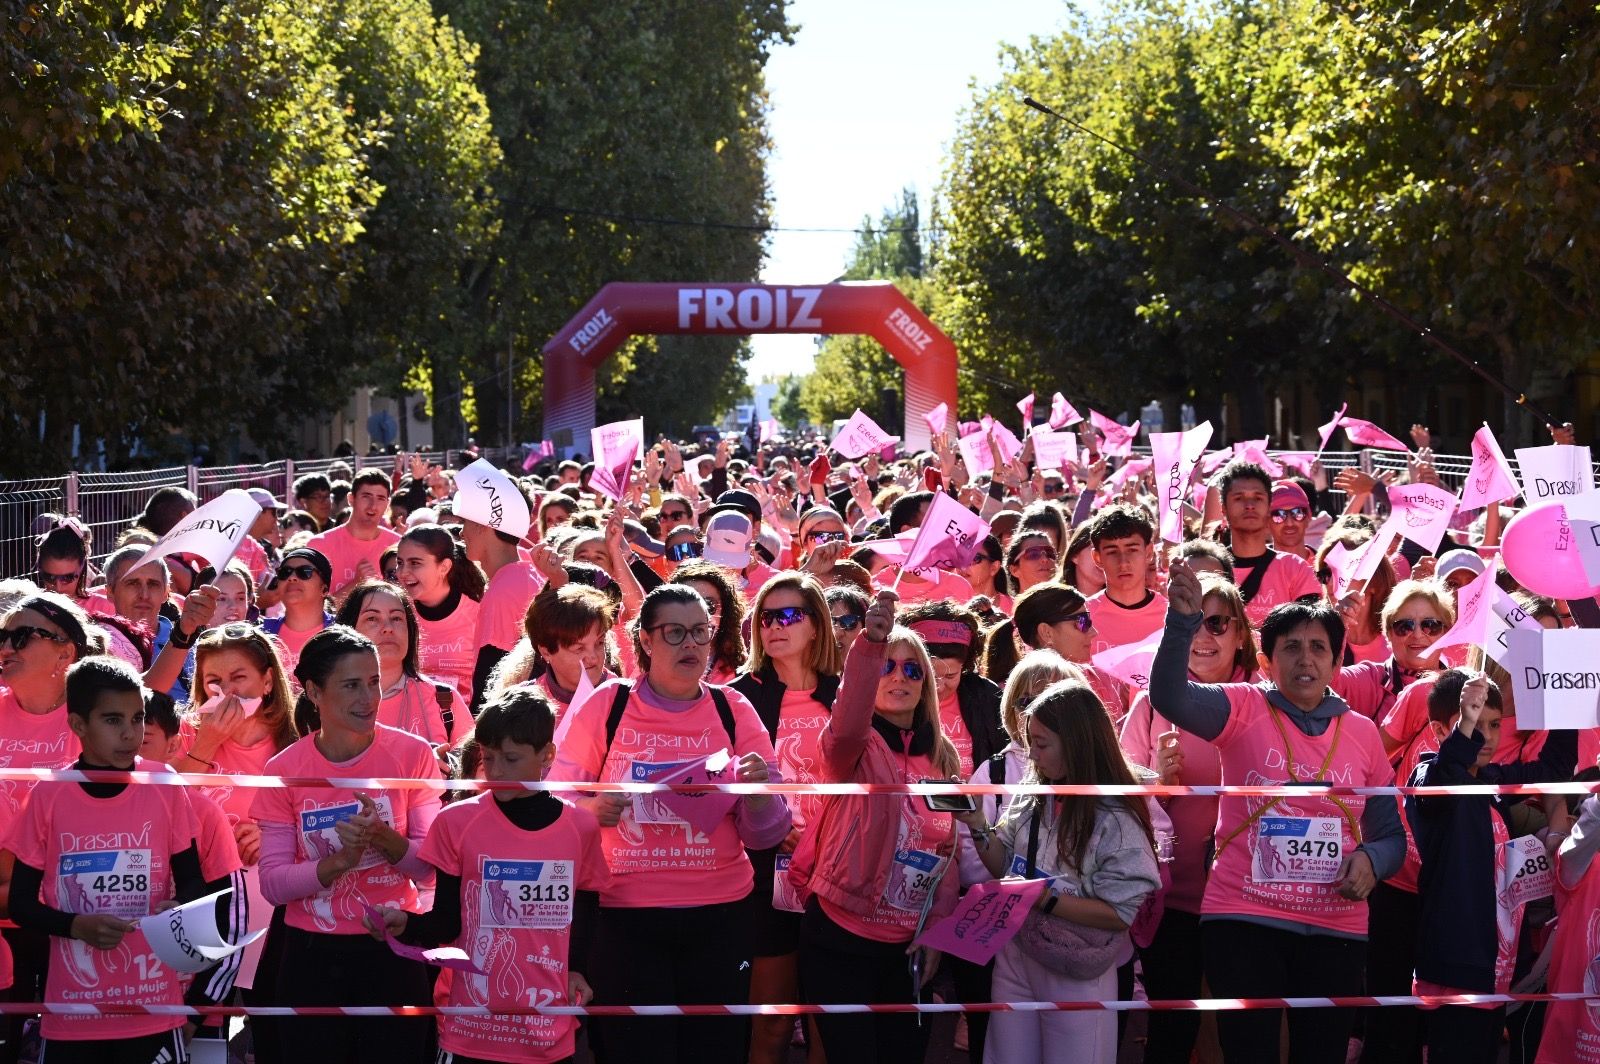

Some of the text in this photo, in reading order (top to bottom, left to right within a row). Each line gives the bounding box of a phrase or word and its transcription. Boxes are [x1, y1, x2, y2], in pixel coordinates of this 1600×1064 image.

[678, 288, 823, 329] FROIZ
[569, 308, 612, 351] FROIZ
[889, 307, 933, 350] FROIZ
[612, 846, 716, 858] Carrera de la Mujer
[1287, 840, 1339, 858] 3479
[652, 859, 716, 867] DRASANVI
[93, 874, 147, 892] 4258
[1296, 884, 1313, 894] de
[519, 884, 569, 902] 3113
[526, 954, 564, 969] SUZUKI
[62, 980, 168, 1000] Carrera de la Mujer
[524, 1014, 554, 1027] Mujer
[492, 1024, 555, 1037] DRASANVI
